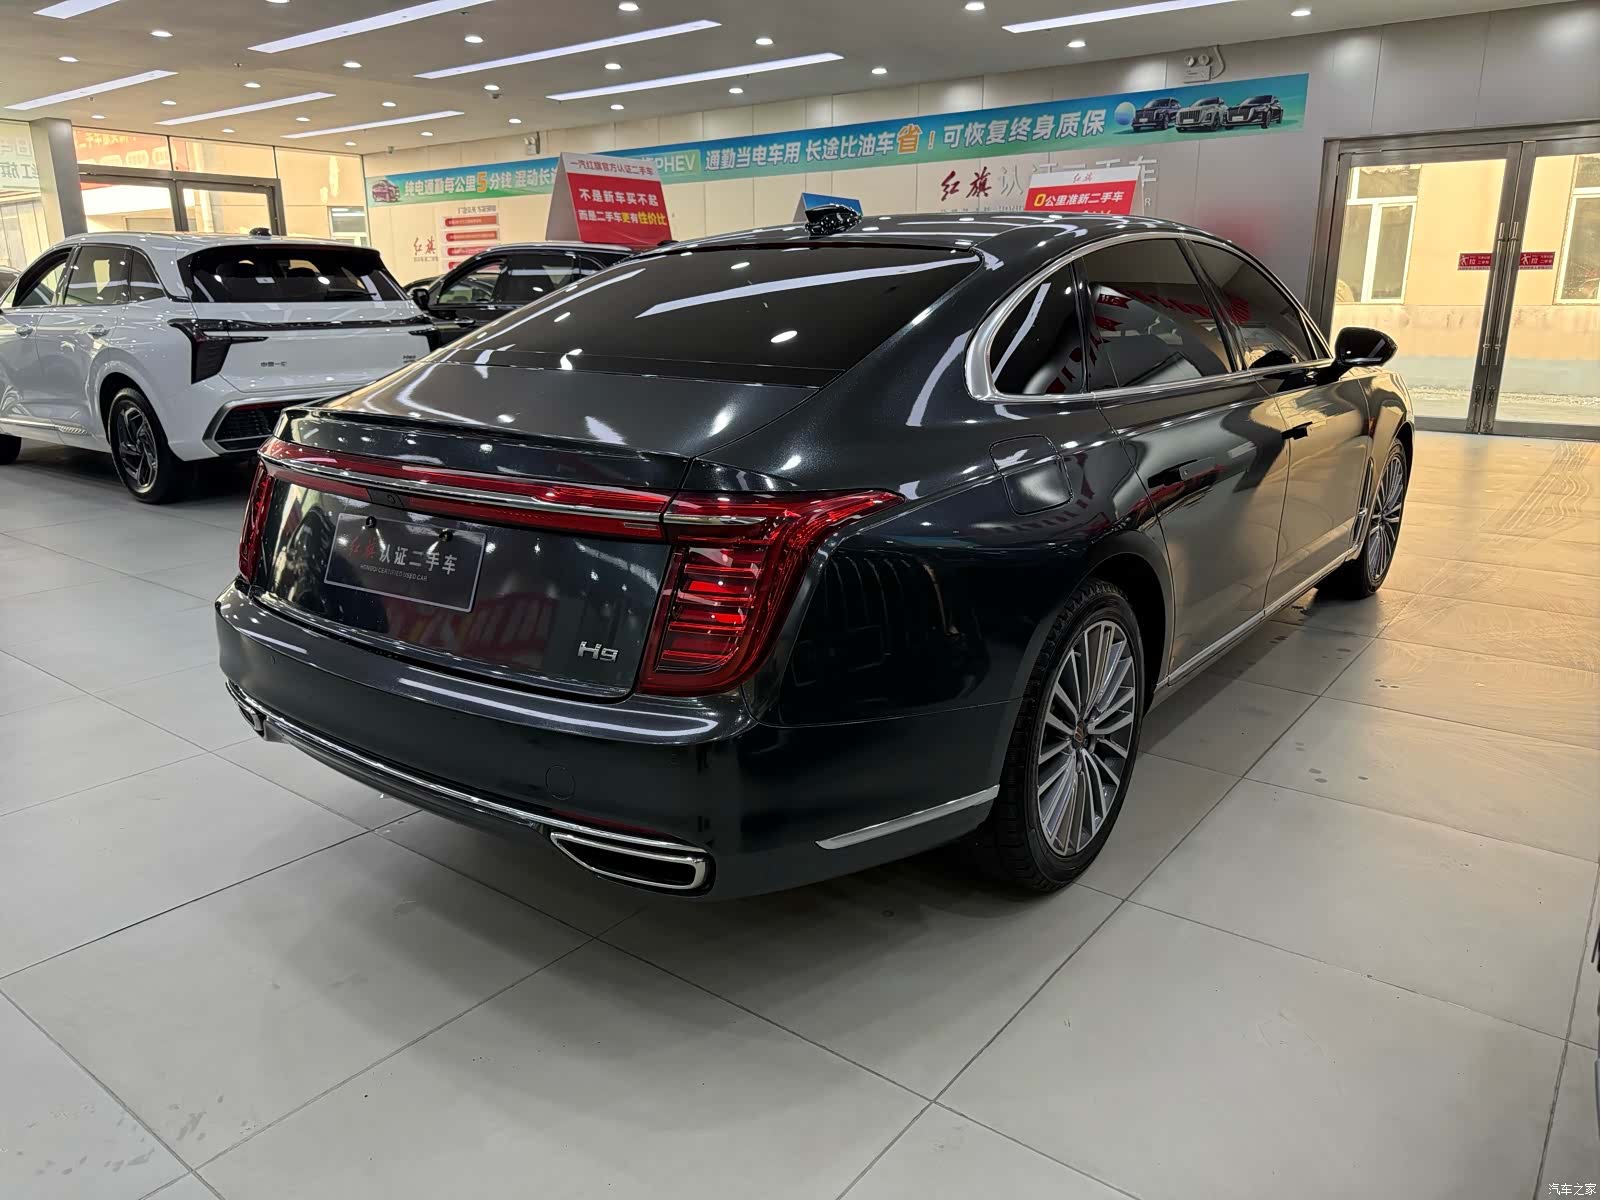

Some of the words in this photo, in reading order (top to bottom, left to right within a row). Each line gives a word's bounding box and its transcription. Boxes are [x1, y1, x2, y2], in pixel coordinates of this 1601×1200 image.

[704, 141, 801, 171] 通勤当电车用
[943, 109, 1107, 149] 可恢复终身质保
[578, 188, 660, 207] 不是新车买不起
[1033, 190, 1125, 208] 0公里准新二手车
[577, 208, 668, 226] 而是二手车更有性价比
[577, 640, 619, 662] H9
